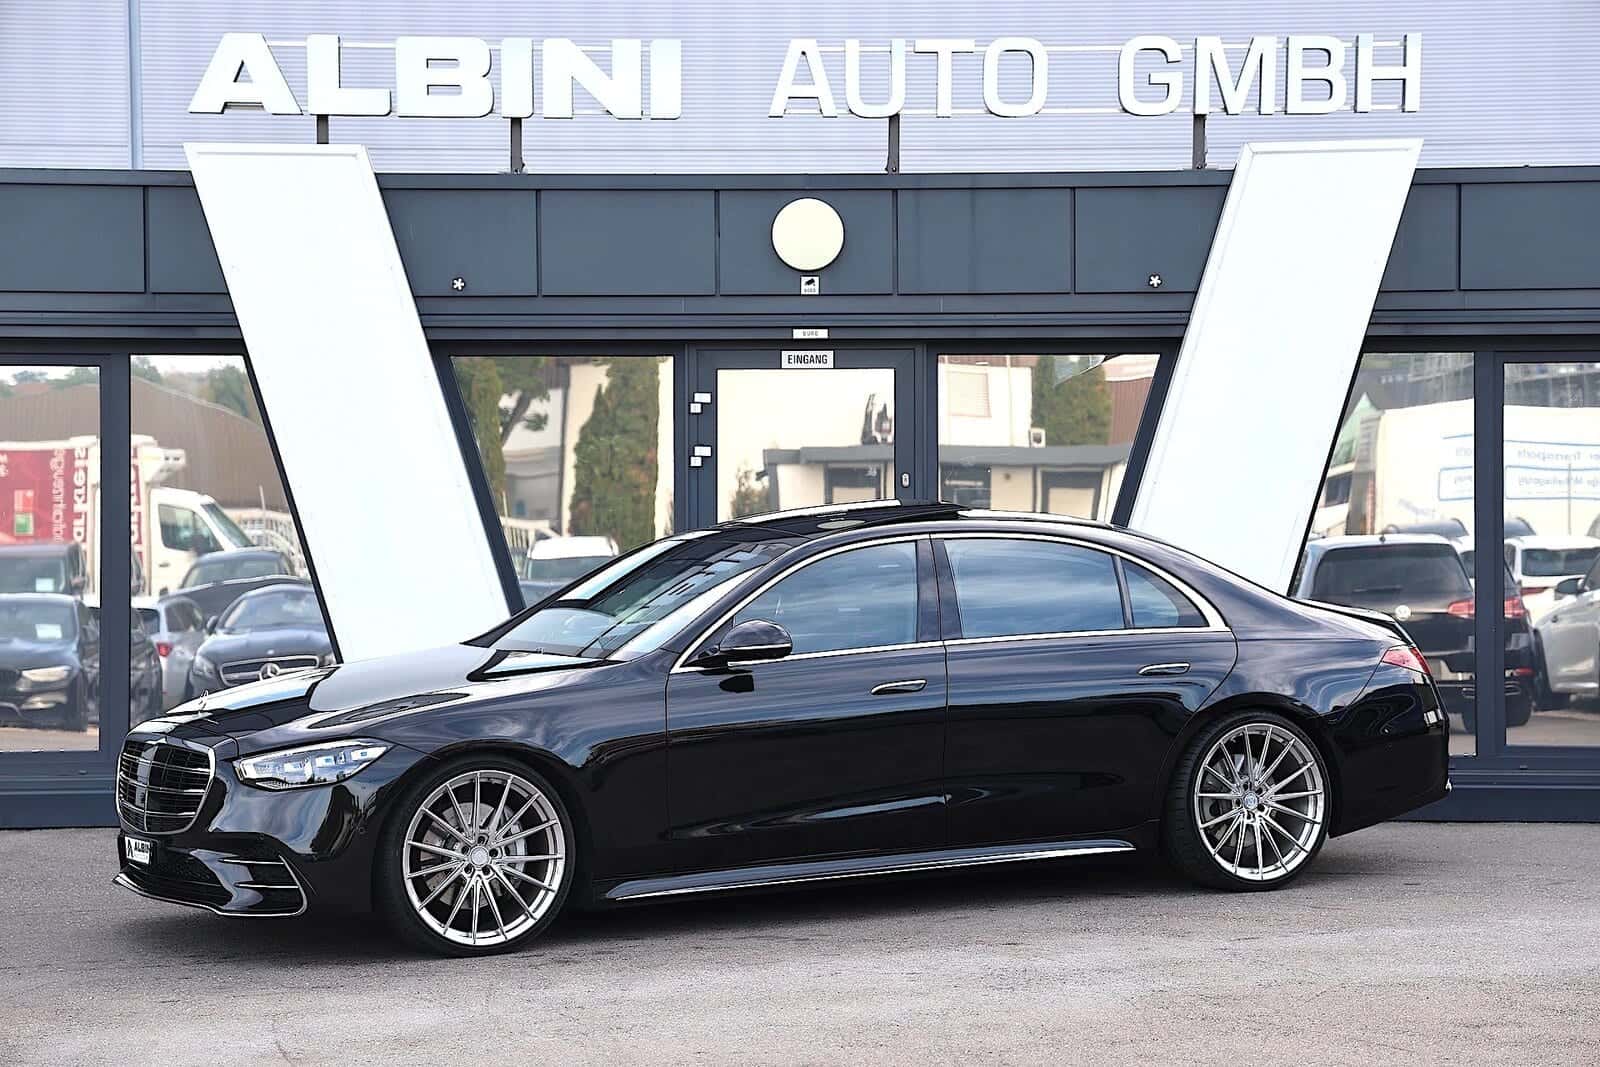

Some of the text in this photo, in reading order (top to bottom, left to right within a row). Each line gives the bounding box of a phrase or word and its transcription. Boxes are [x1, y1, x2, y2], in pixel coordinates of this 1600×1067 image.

[188, 32, 1423, 120] ALBINI AUTO GMBH
[787, 354, 828, 365] EINGANG
